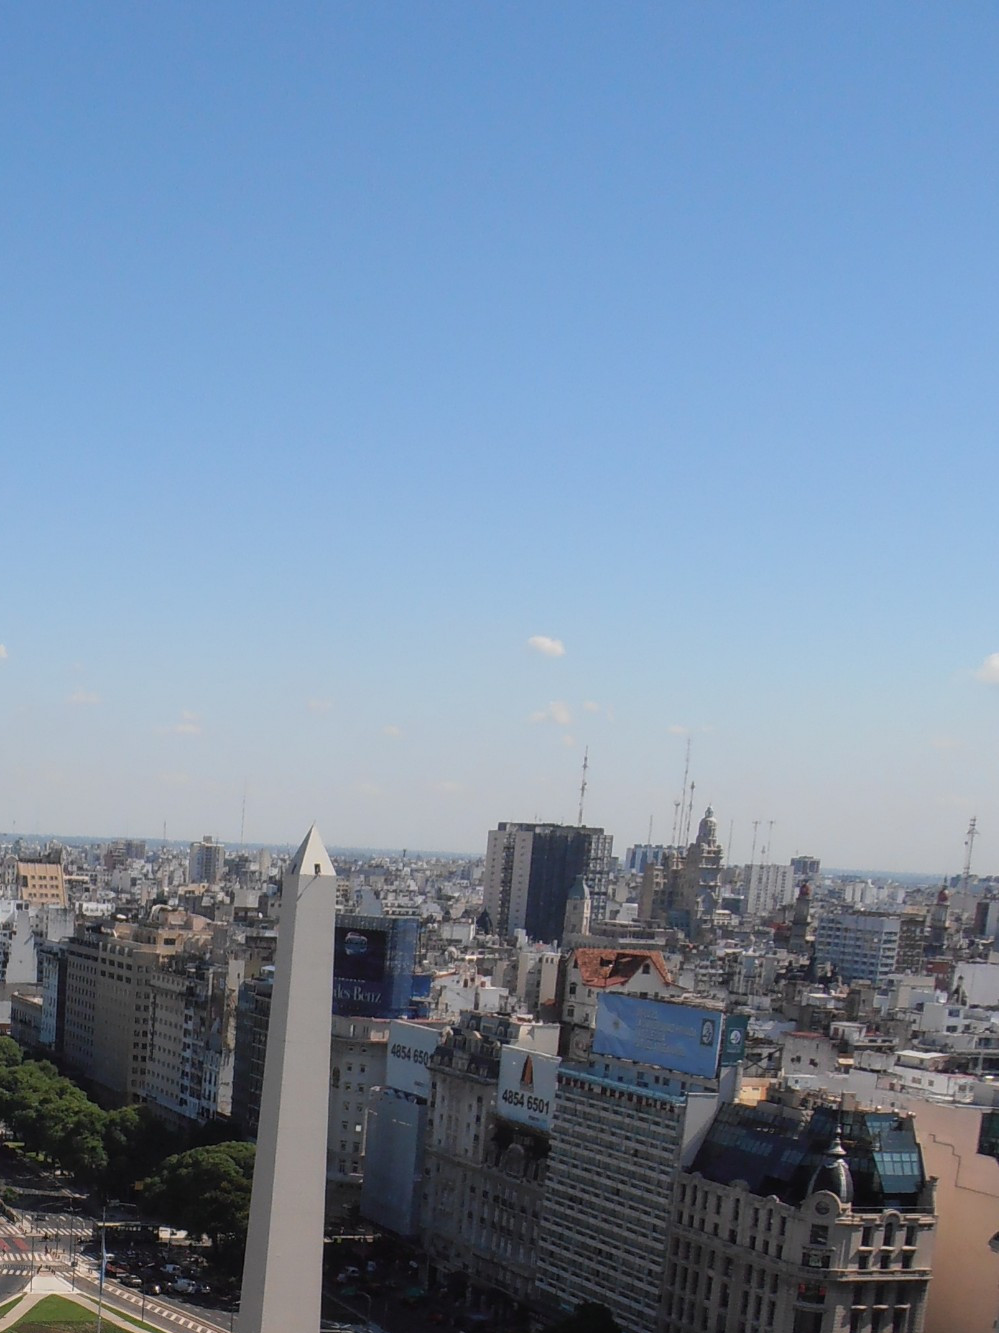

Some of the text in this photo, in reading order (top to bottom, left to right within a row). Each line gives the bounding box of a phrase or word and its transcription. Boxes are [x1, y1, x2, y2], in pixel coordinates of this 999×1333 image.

[391, 1043, 411, 1061] 4854
[502, 1089, 550, 1115] 4854 6501
